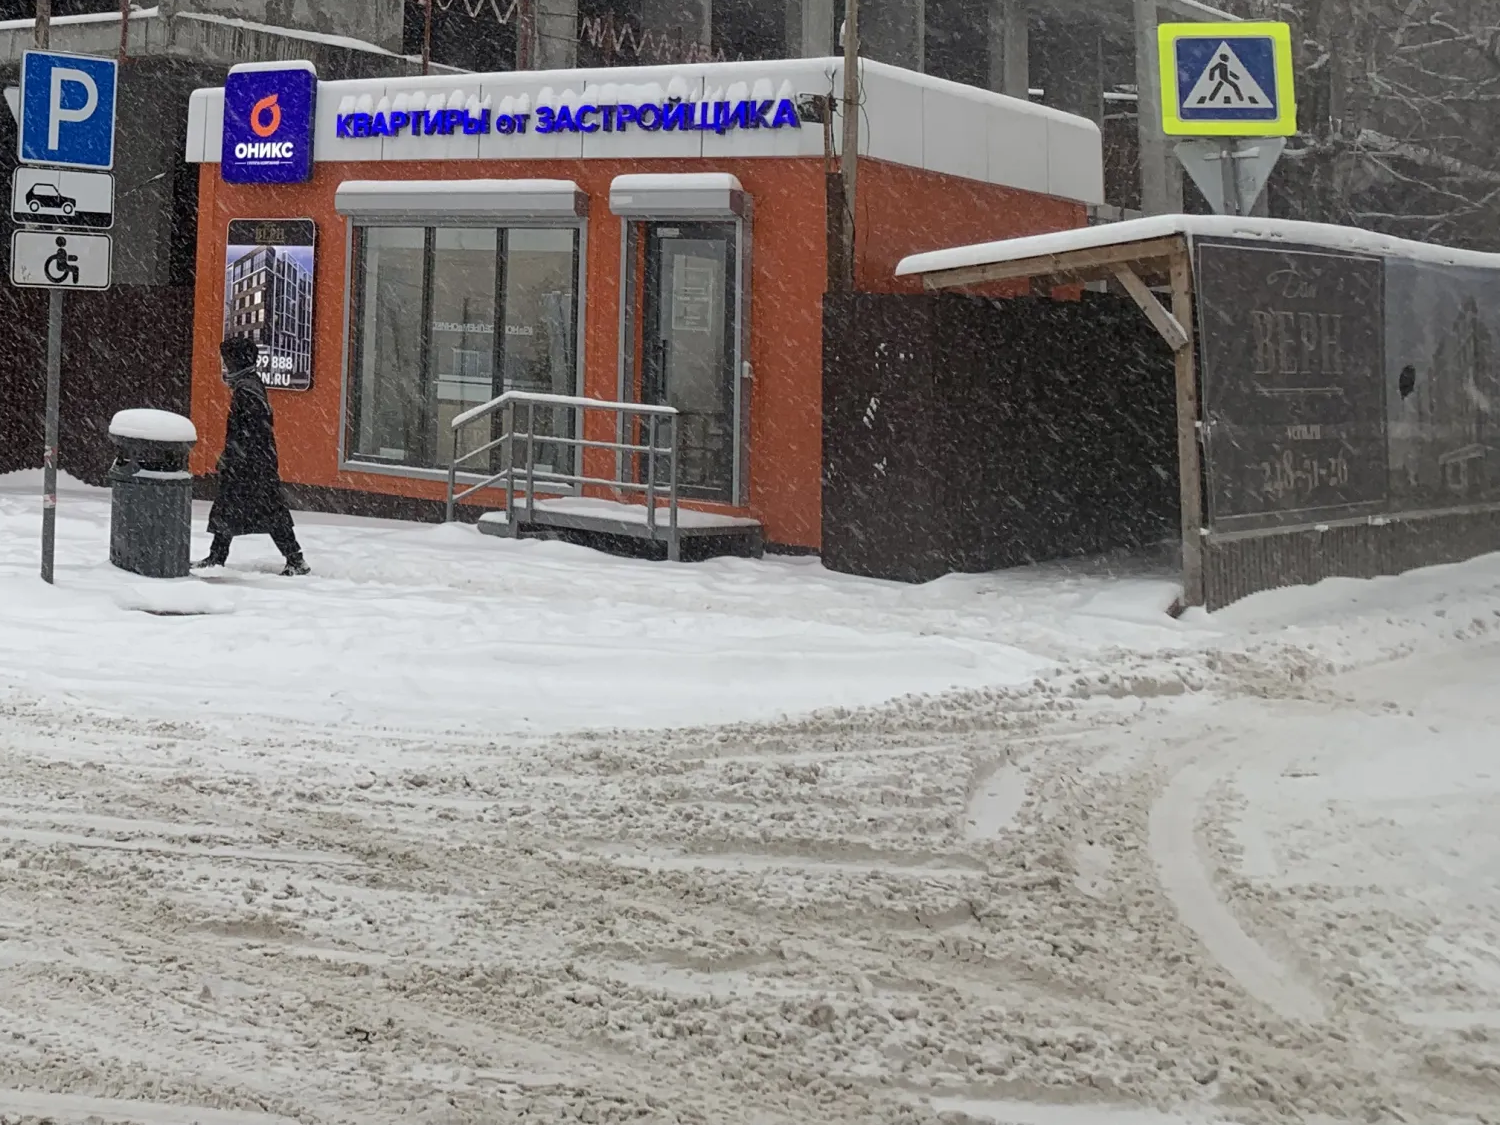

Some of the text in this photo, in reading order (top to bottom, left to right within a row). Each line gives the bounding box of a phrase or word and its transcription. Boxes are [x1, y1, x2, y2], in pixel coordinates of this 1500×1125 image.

[47, 66, 99, 151] P
[336, 96, 801, 139] КВАРТИРЫ от ЗАСТРОЙЩИКА
[234, 141, 294, 159] ОНИКС
[271, 356, 293, 370] 888
[1250, 310, 1343, 374] ВЕРН
